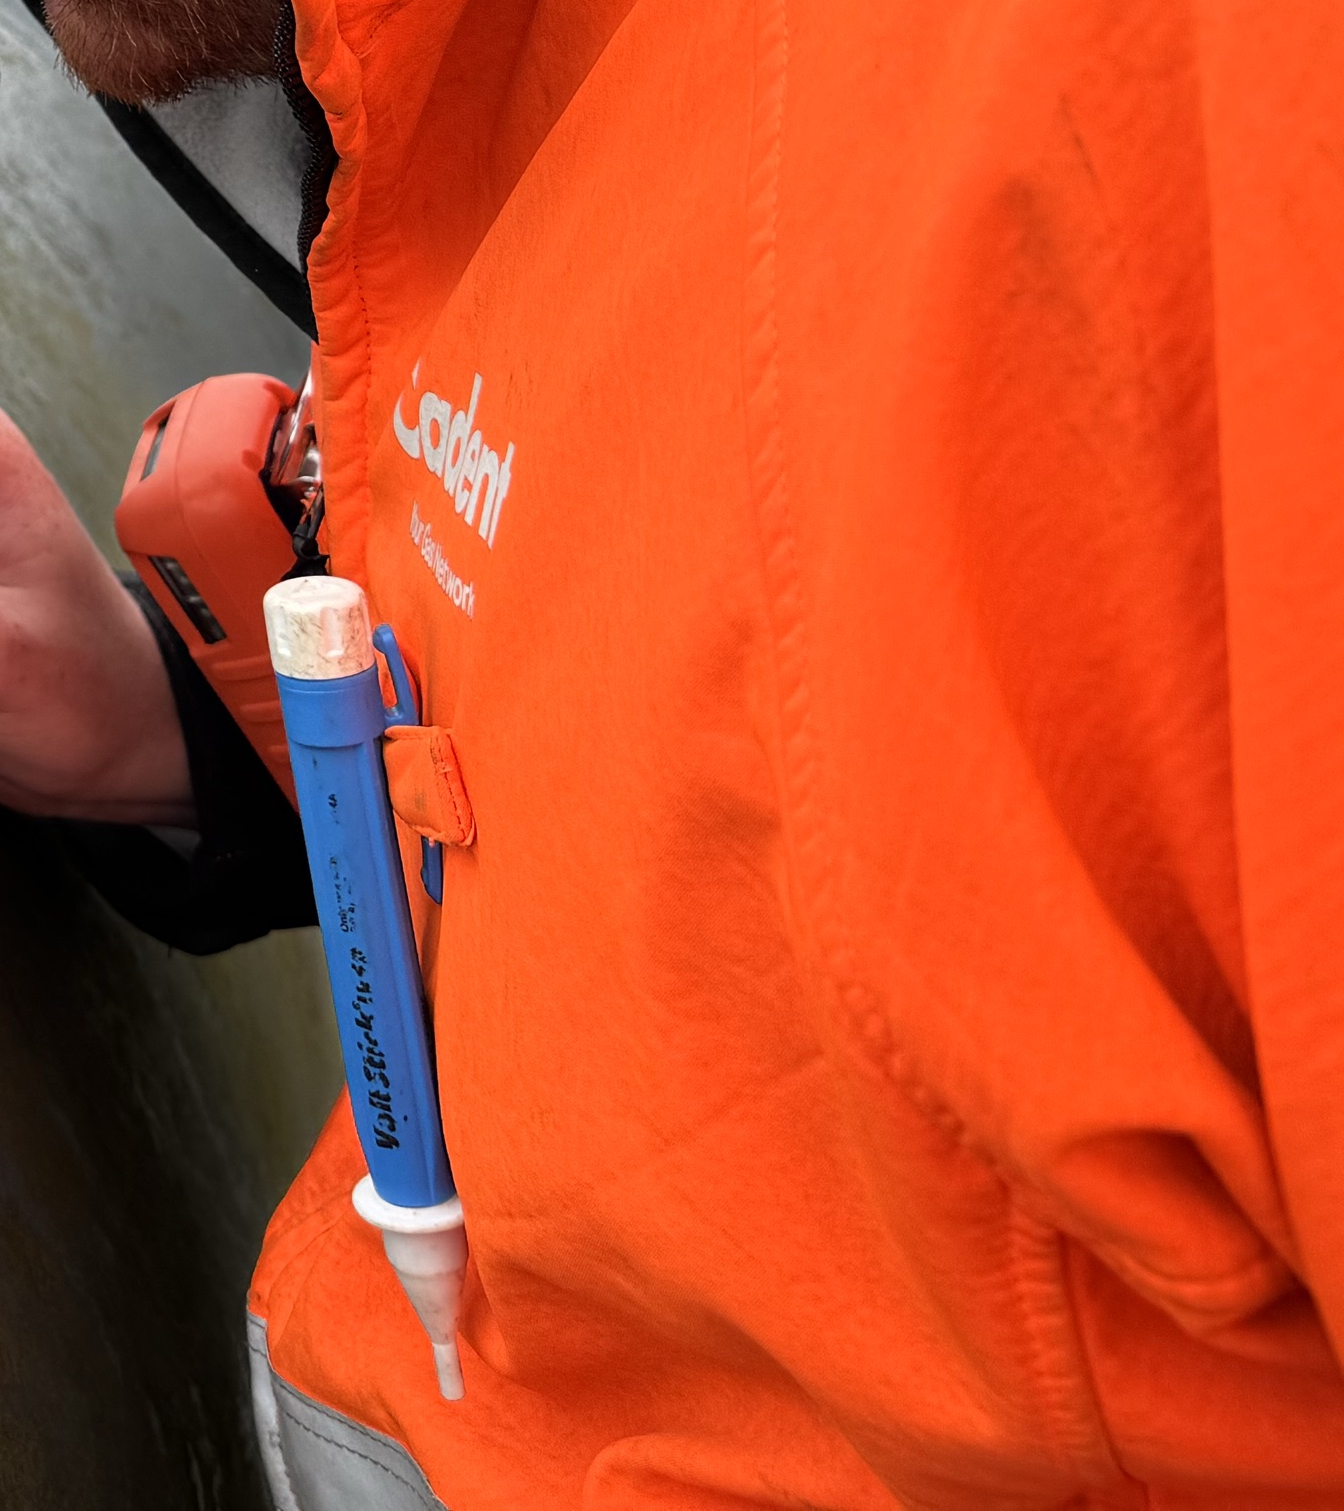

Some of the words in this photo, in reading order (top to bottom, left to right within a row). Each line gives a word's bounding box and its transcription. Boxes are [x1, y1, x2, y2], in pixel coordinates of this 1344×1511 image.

[393, 356, 515, 550] Cadent
[421, 522, 435, 568] Gas
[432, 542, 476, 620] Network
